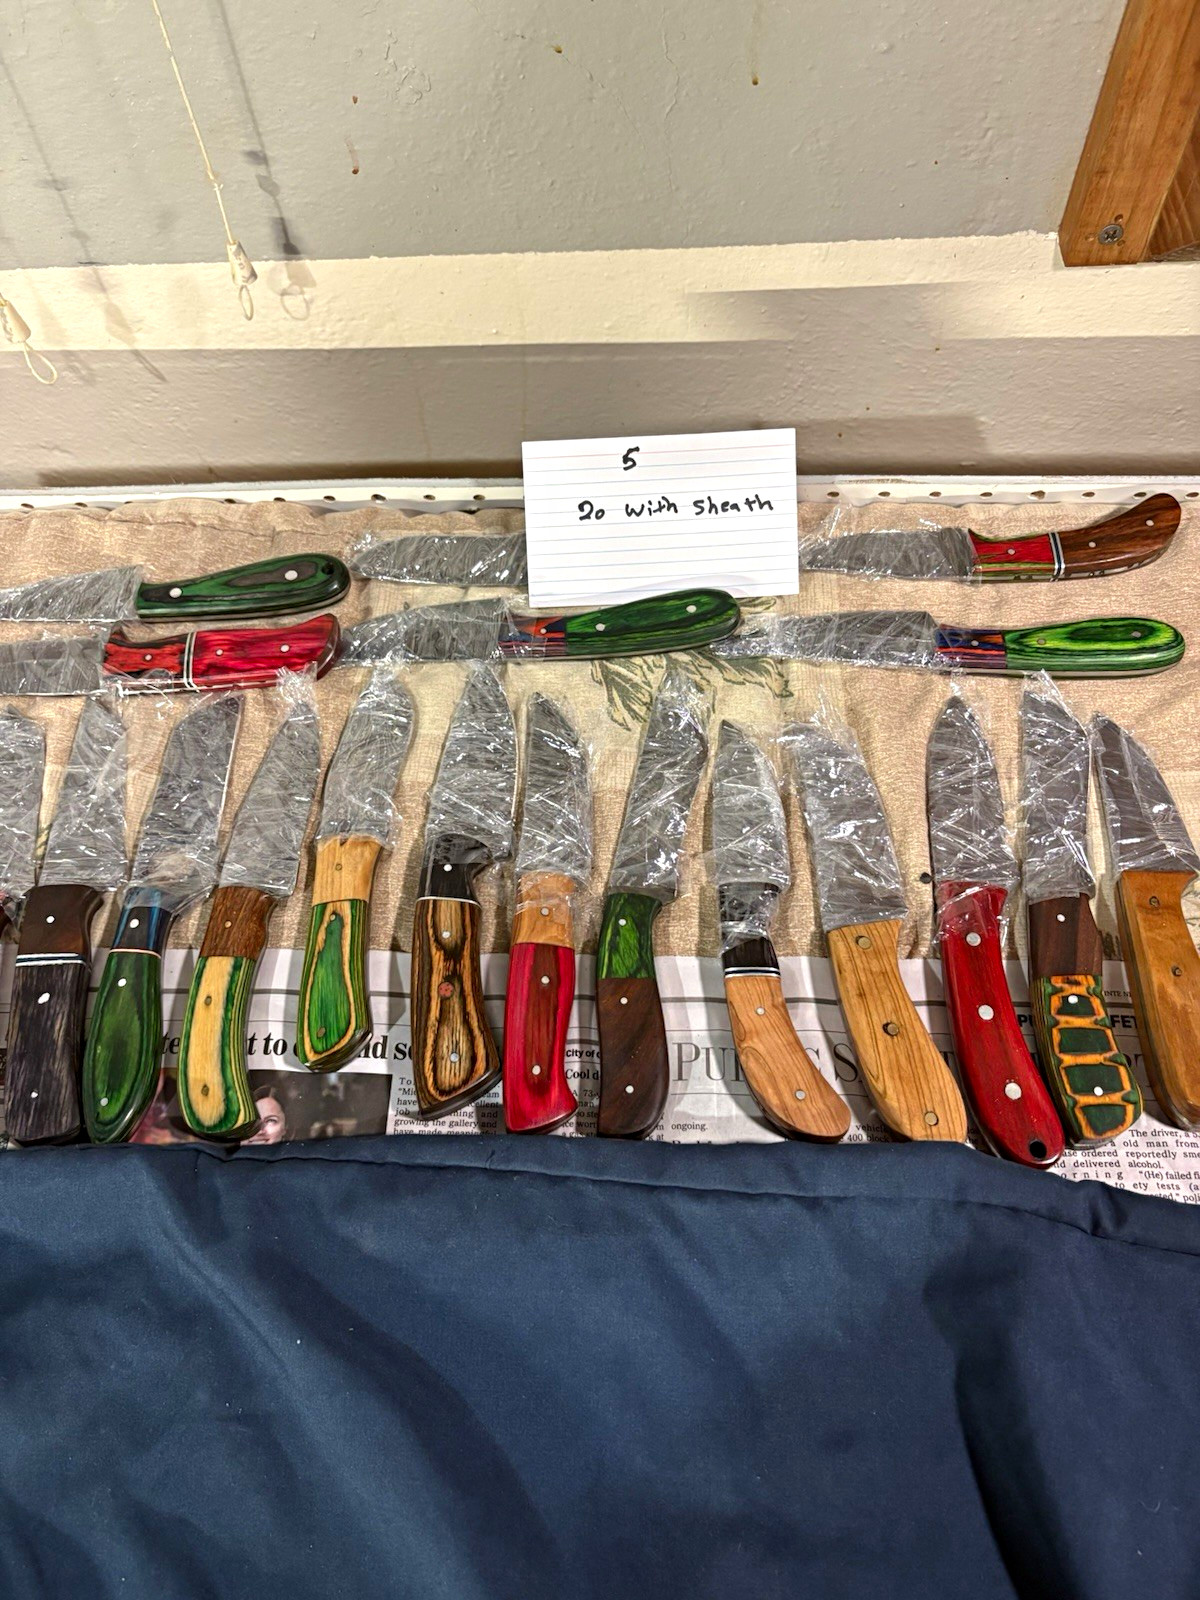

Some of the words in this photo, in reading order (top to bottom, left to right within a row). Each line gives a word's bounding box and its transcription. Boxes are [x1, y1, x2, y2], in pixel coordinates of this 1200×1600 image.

[621, 446, 640, 471] 5
[577, 500, 606, 521] 20
[263, 1032, 288, 1056] to
[586, 1049, 596, 1058] of
[565, 1068, 590, 1080] Cool
[394, 1107, 410, 1117] job
[394, 1118, 430, 1129] growing
[448, 1119, 478, 1129] gallery
[671, 1123, 708, 1132] ongoing.
[1129, 1129, 1148, 1138] The
[1151, 1128, 1182, 1139] driver,
[1123, 1139, 1139, 1148] old
[1175, 1139, 1199, 1148] from
[1081, 1148, 1118, 1158] ordered
[1125, 1149, 1177, 1160] reportedly
[1073, 1159, 1121, 1168] delivered
[1128, 1160, 1164, 1169] alcohol.
[1165, 1171, 1192, 1180] failed
[1132, 1181, 1149, 1191] ety
[1156, 1182, 1181, 1190] tests
